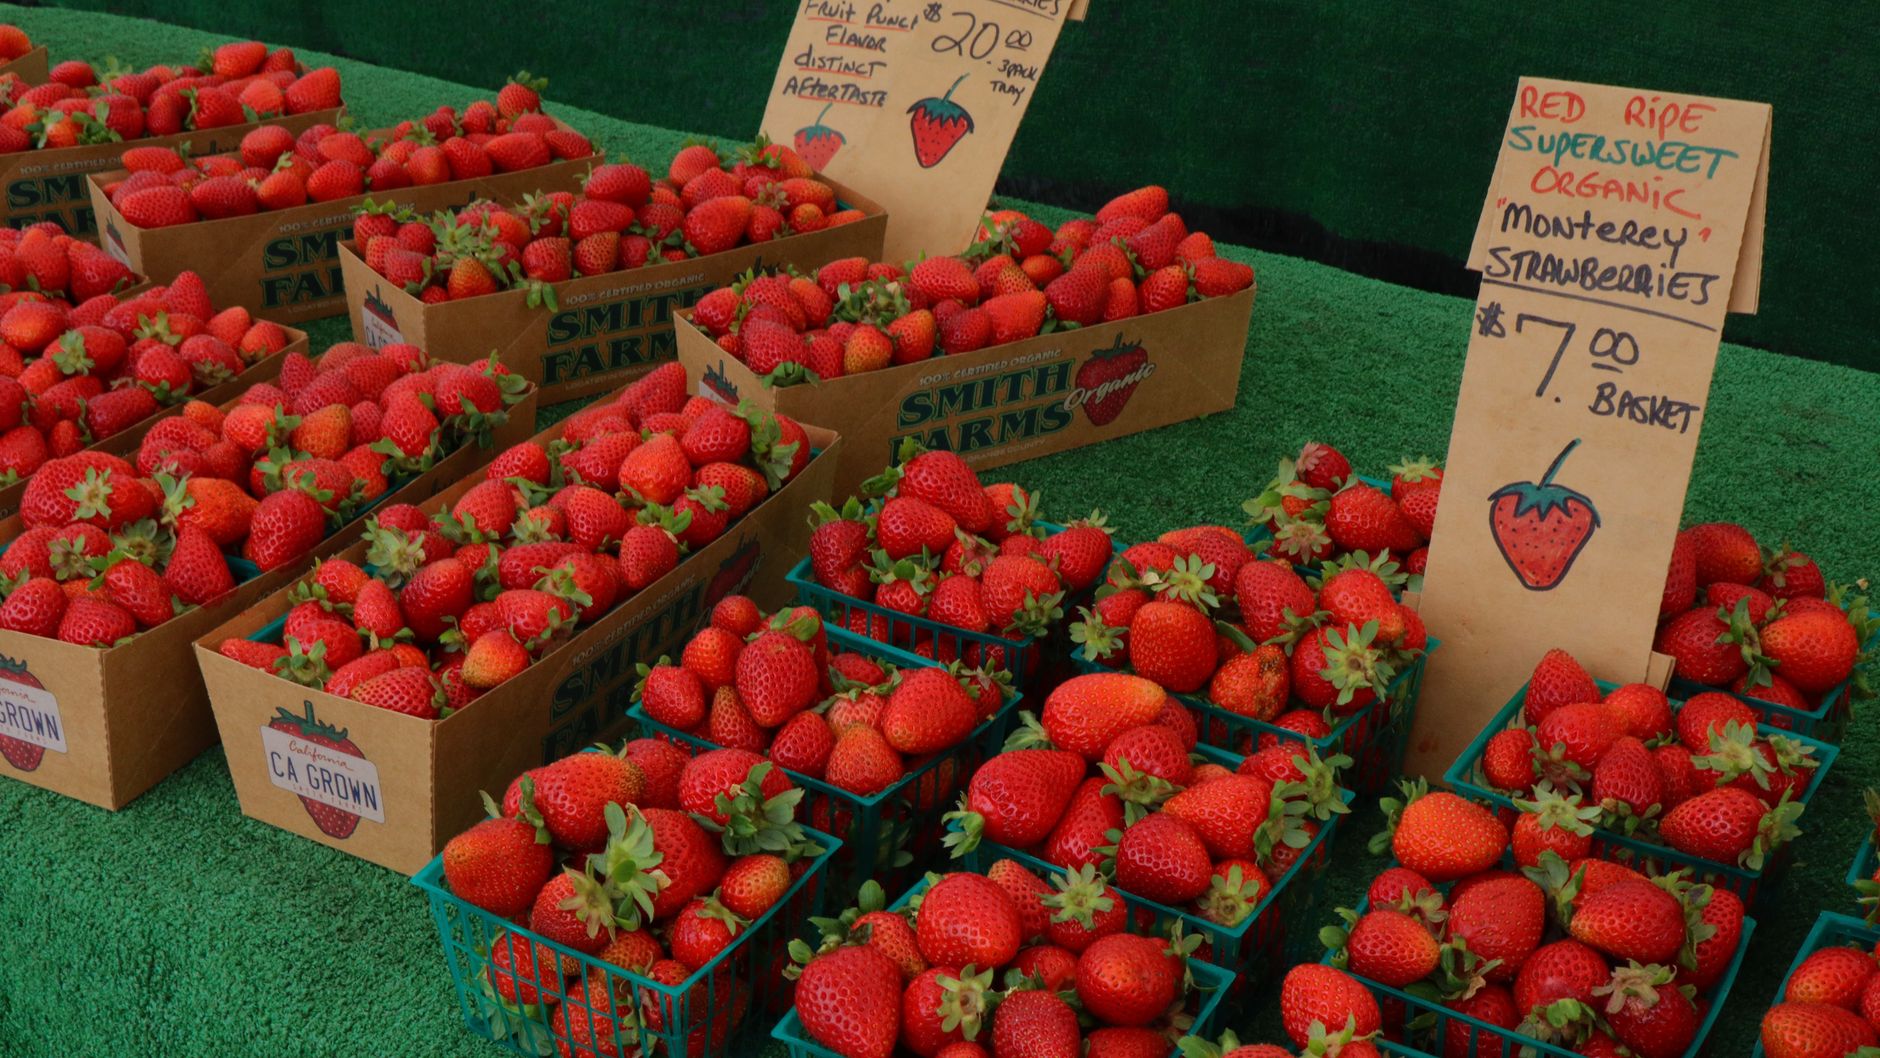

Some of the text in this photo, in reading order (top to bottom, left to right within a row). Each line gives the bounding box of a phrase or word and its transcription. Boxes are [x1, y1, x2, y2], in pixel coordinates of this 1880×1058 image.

[990, 80, 1026, 106] TRAY
[1519, 85, 1586, 123] RED
[1507, 125, 1739, 180] SUPERSWEET
[312, 212, 357, 227] CERTIFI
[541, 329, 678, 387] FARM
[953, 359, 1009, 380] CERTIFIED
[1009, 348, 1062, 367] ORGANIC
[897, 358, 1076, 430] SMITH
[1063, 360, 1157, 412] Organic
[1588, 382, 1701, 433] BASKET
[288, 739, 355, 772] California
[270, 751, 378, 812] CA GROWN
